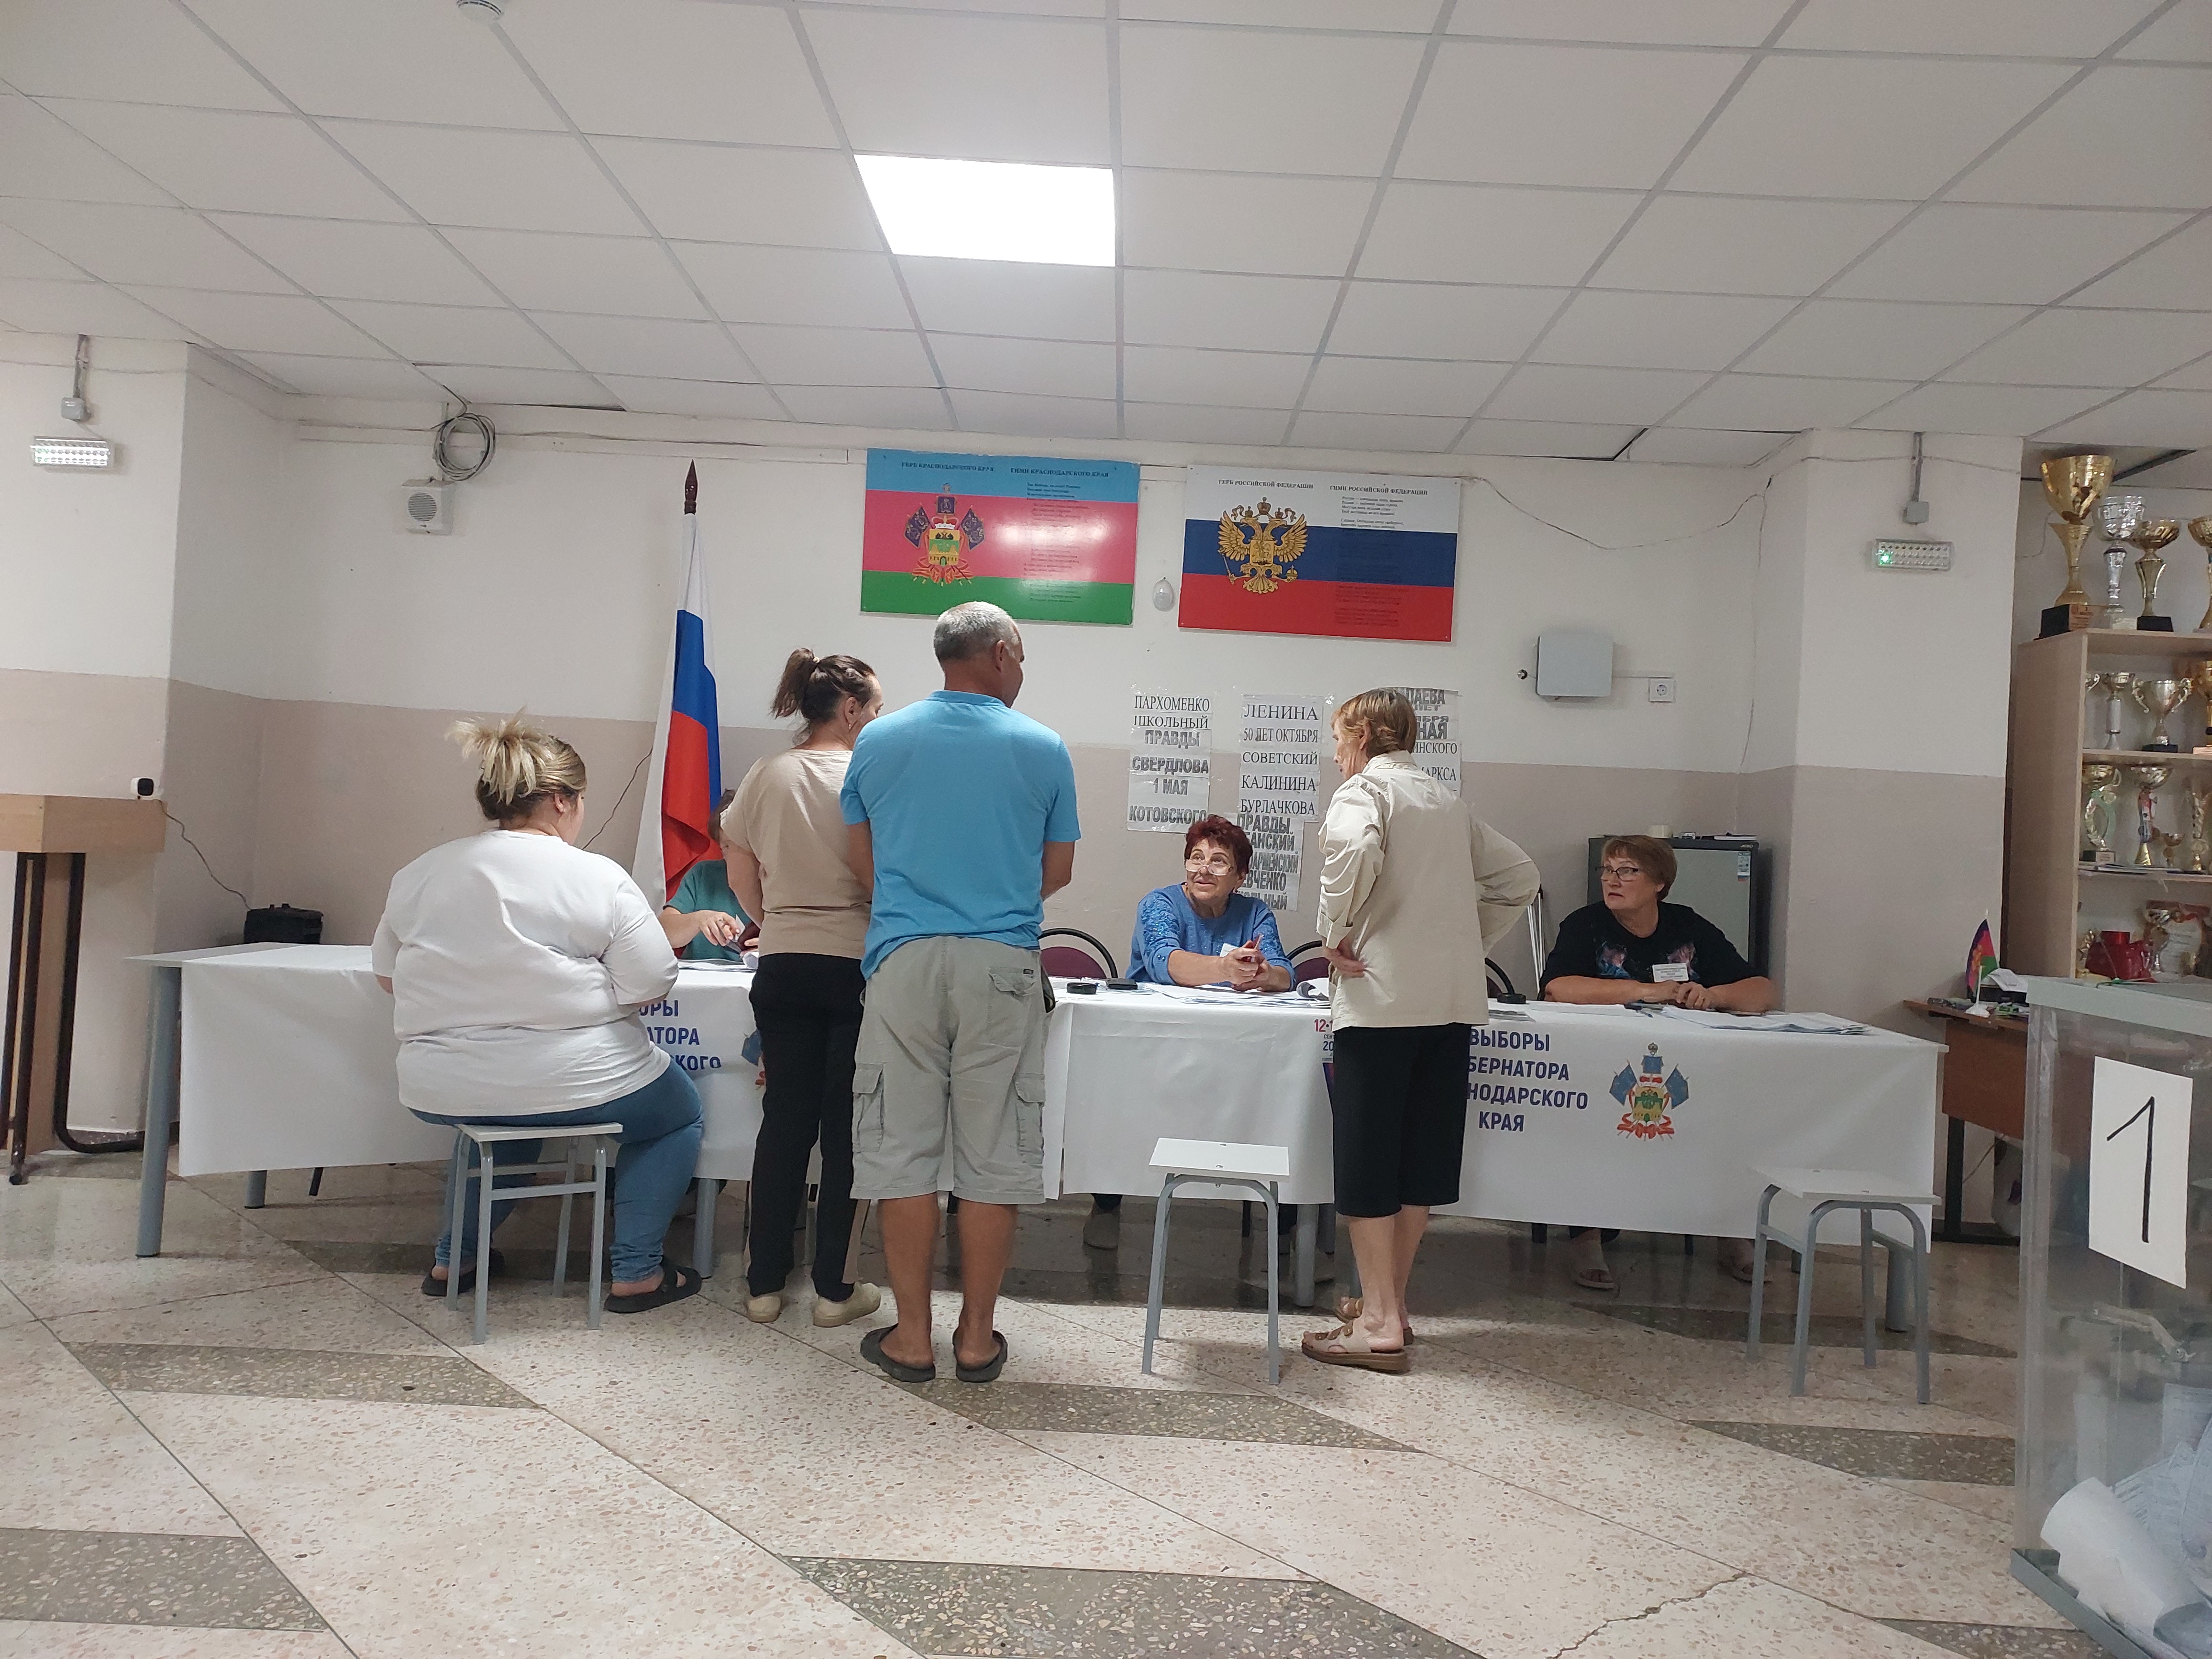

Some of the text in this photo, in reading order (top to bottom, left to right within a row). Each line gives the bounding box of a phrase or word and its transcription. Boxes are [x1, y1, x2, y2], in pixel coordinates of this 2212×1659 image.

[1134, 695, 1210, 712] ПАРХОМЕНКО
[1244, 704, 1319, 720] ЛЕНИНА
[1134, 715, 1209, 729] ШКОЛЬНЫЙ
[1144, 730, 1200, 749] ПРАВДЫ
[1243, 728, 1319, 743] 50 ЛЕТ ОКТЯБРЯ
[1132, 756, 1209, 775] СВЕРДЛОВА
[1242, 751, 1319, 765] СОВЕТСКИЙ
[1421, 766, 1456, 781] АРКСА
[1153, 778, 1188, 795] 1 МАЯ
[1241, 774, 1316, 791] КАЛИНИНА
[1129, 805, 1207, 824] КОТОВСКОГО
[1240, 799, 1315, 815] БУРЛАЧКОВА
[1237, 813, 1291, 834] ПРАВДЫ
[1470, 1029, 1549, 1051] ВЫБОРЫ
[1479, 1111, 1525, 1132] КРАЯ
[2107, 1096, 2155, 1243] 1
